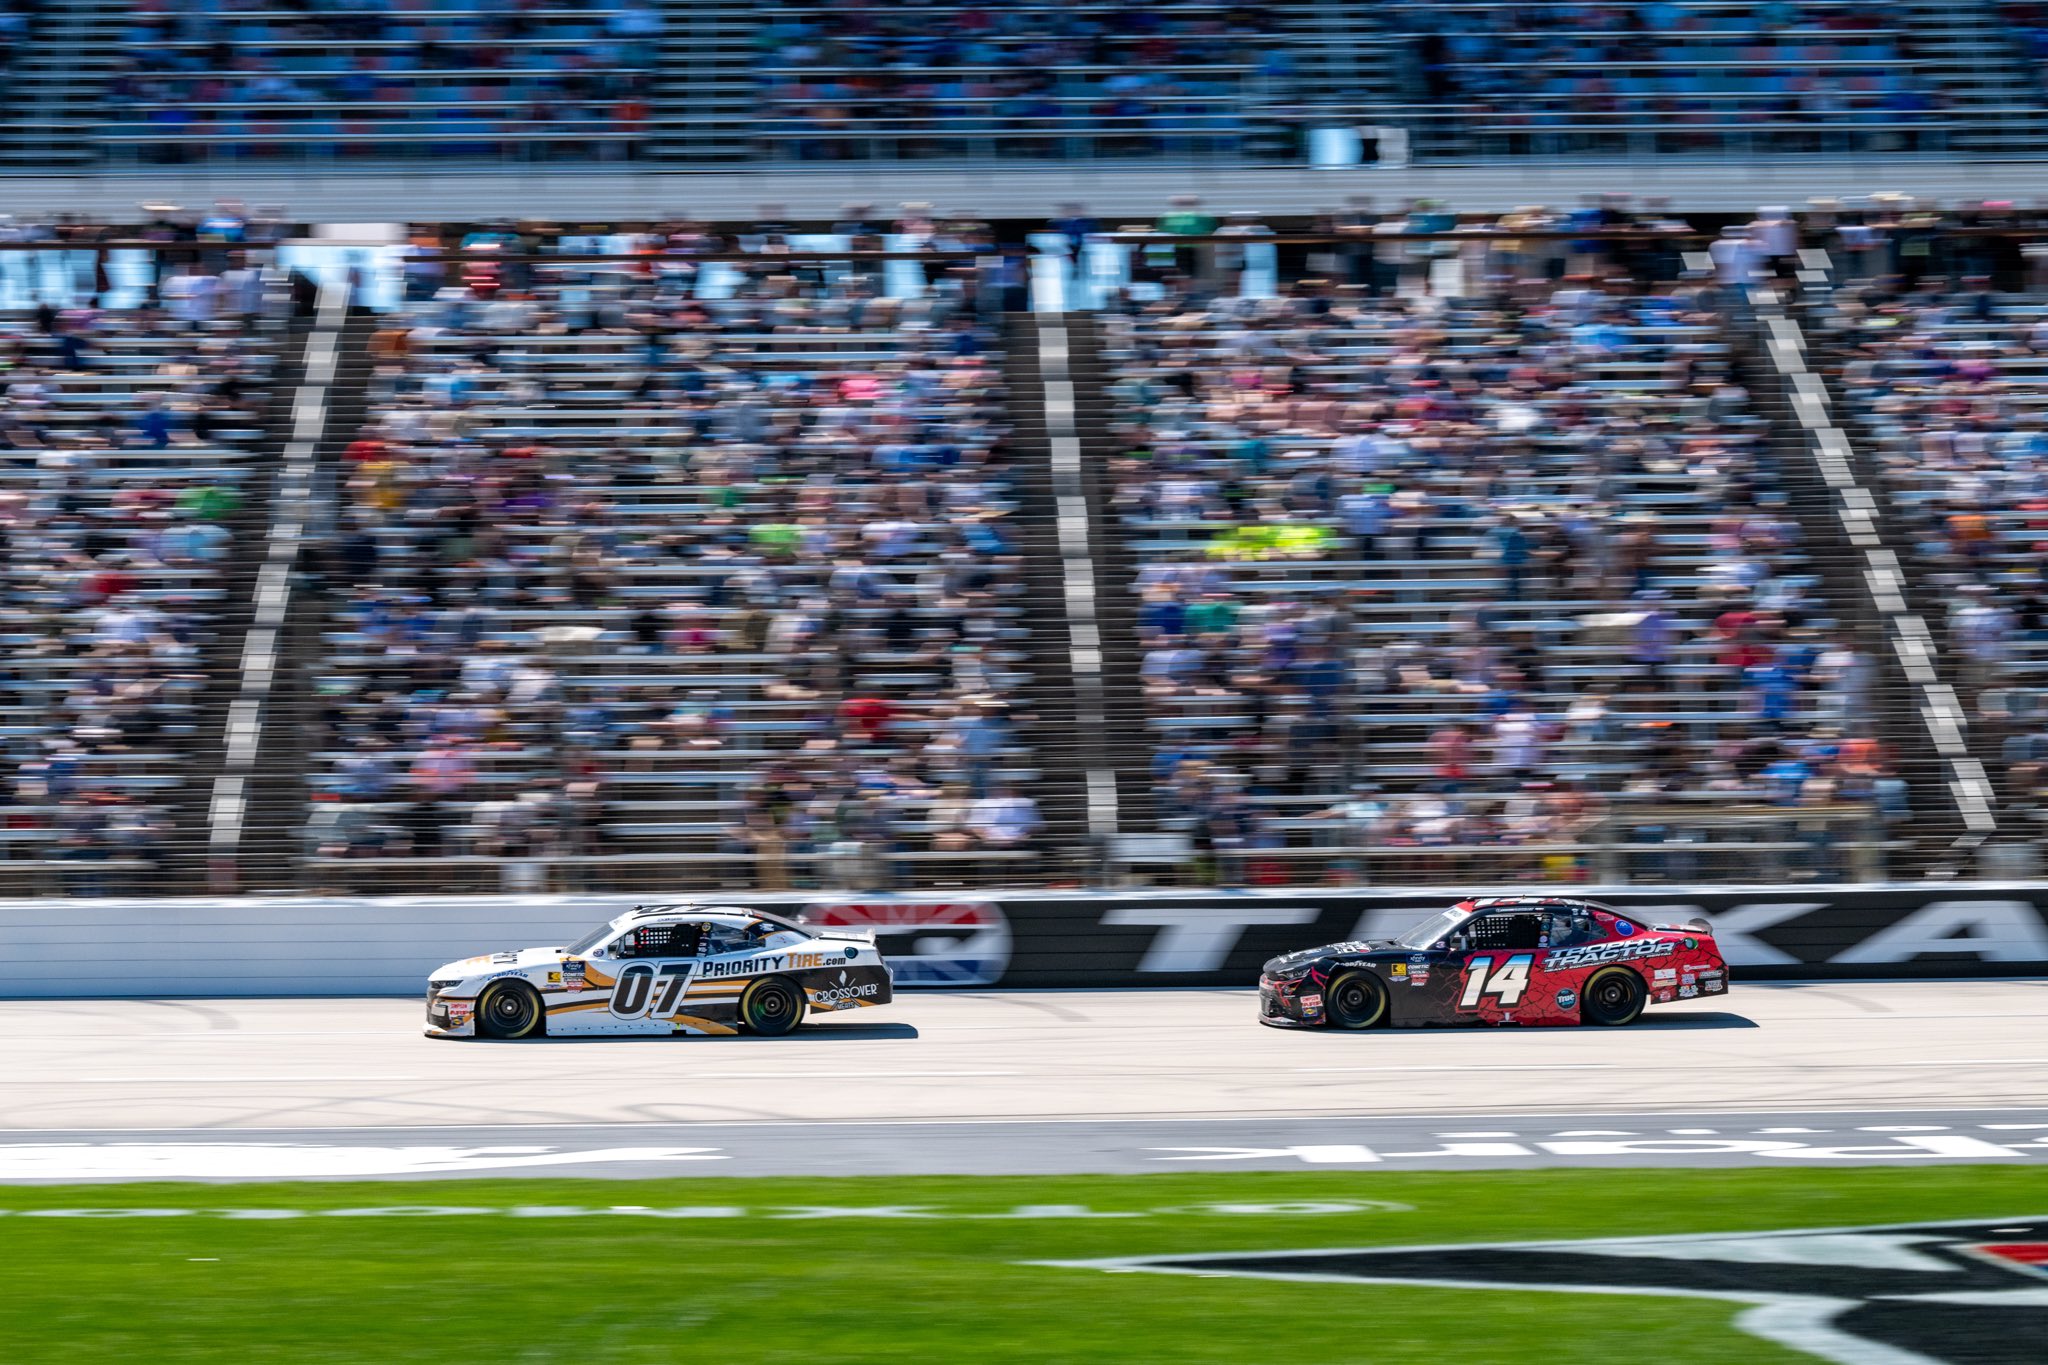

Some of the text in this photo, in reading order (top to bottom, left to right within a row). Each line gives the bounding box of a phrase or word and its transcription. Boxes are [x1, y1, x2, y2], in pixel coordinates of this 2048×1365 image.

[1545, 943, 1674, 968] TRACTOR
[1551, 937, 1664, 958] TROPHY
[703, 955, 784, 977] PRIORITY
[609, 960, 699, 1019] 07
[1460, 955, 1535, 1008] 14
[814, 984, 877, 1003] CROSSOVER
[1557, 993, 1575, 1003] True
[1141, 1135, 2048, 1163] Park
[0, 1198, 1416, 1219] @TXMoto
